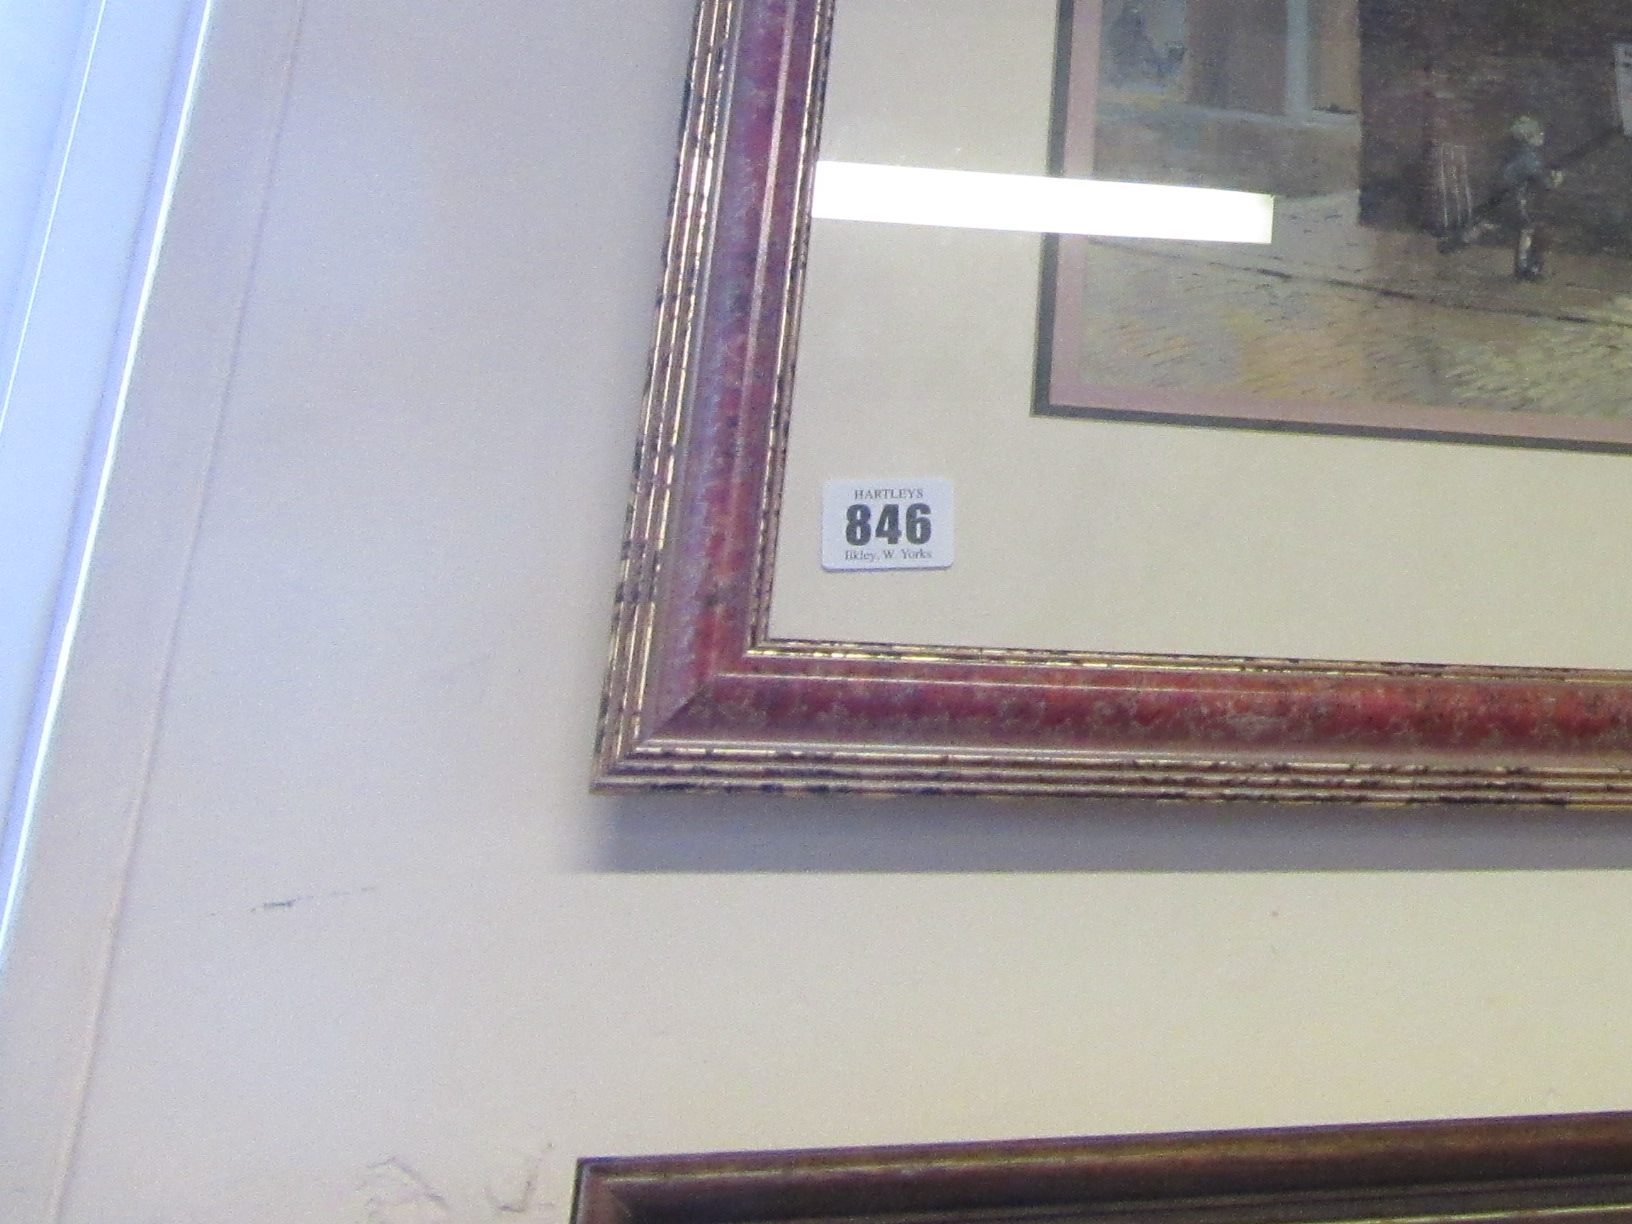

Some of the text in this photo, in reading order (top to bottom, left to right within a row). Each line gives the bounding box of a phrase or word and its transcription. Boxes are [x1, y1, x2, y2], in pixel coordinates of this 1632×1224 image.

[855, 488, 924, 500] HARTLEYS
[846, 503, 931, 546] 846
[902, 549, 933, 560] Yorks
